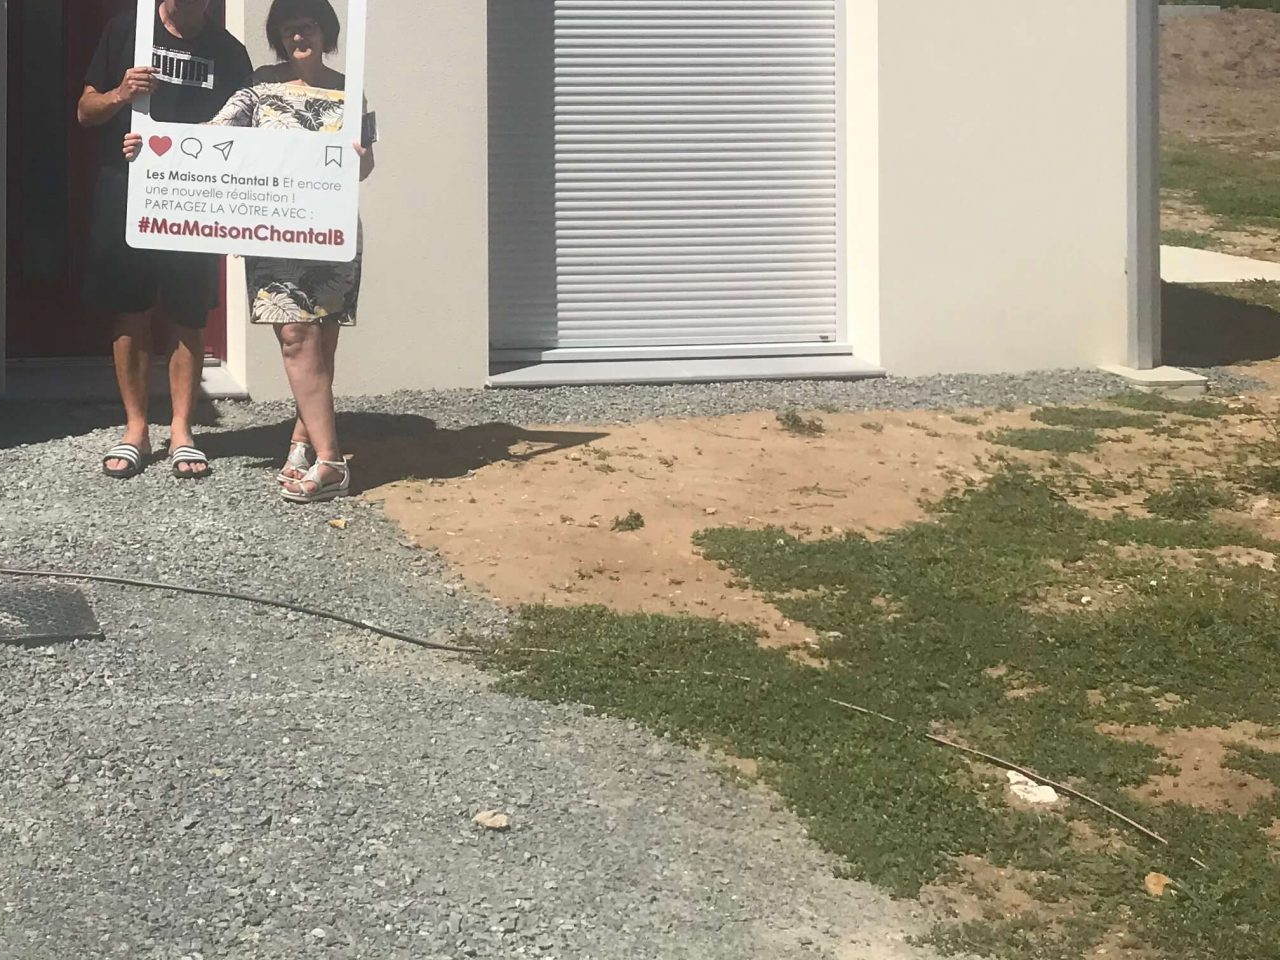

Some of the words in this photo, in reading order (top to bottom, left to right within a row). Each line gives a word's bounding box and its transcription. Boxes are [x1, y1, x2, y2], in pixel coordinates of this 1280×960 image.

[146, 170, 164, 180] Les
[169, 171, 217, 183] Maisons
[221, 173, 268, 186] Chantal
[273, 178, 279, 186] B
[283, 178, 294, 188] Et
[298, 181, 341, 191] encore
[145, 185, 168, 195] une
[172, 187, 223, 198] nouvelle
[226, 191, 289, 202] réalisation
[292, 193, 295, 202] !
[145, 199, 206, 212] PARTAGEZ
[211, 204, 224, 213] LA
[230, 202, 268, 216] VÔTRE
[271, 208, 306, 219] AVEC
[138, 216, 344, 246] #MaMaisonChantalB
